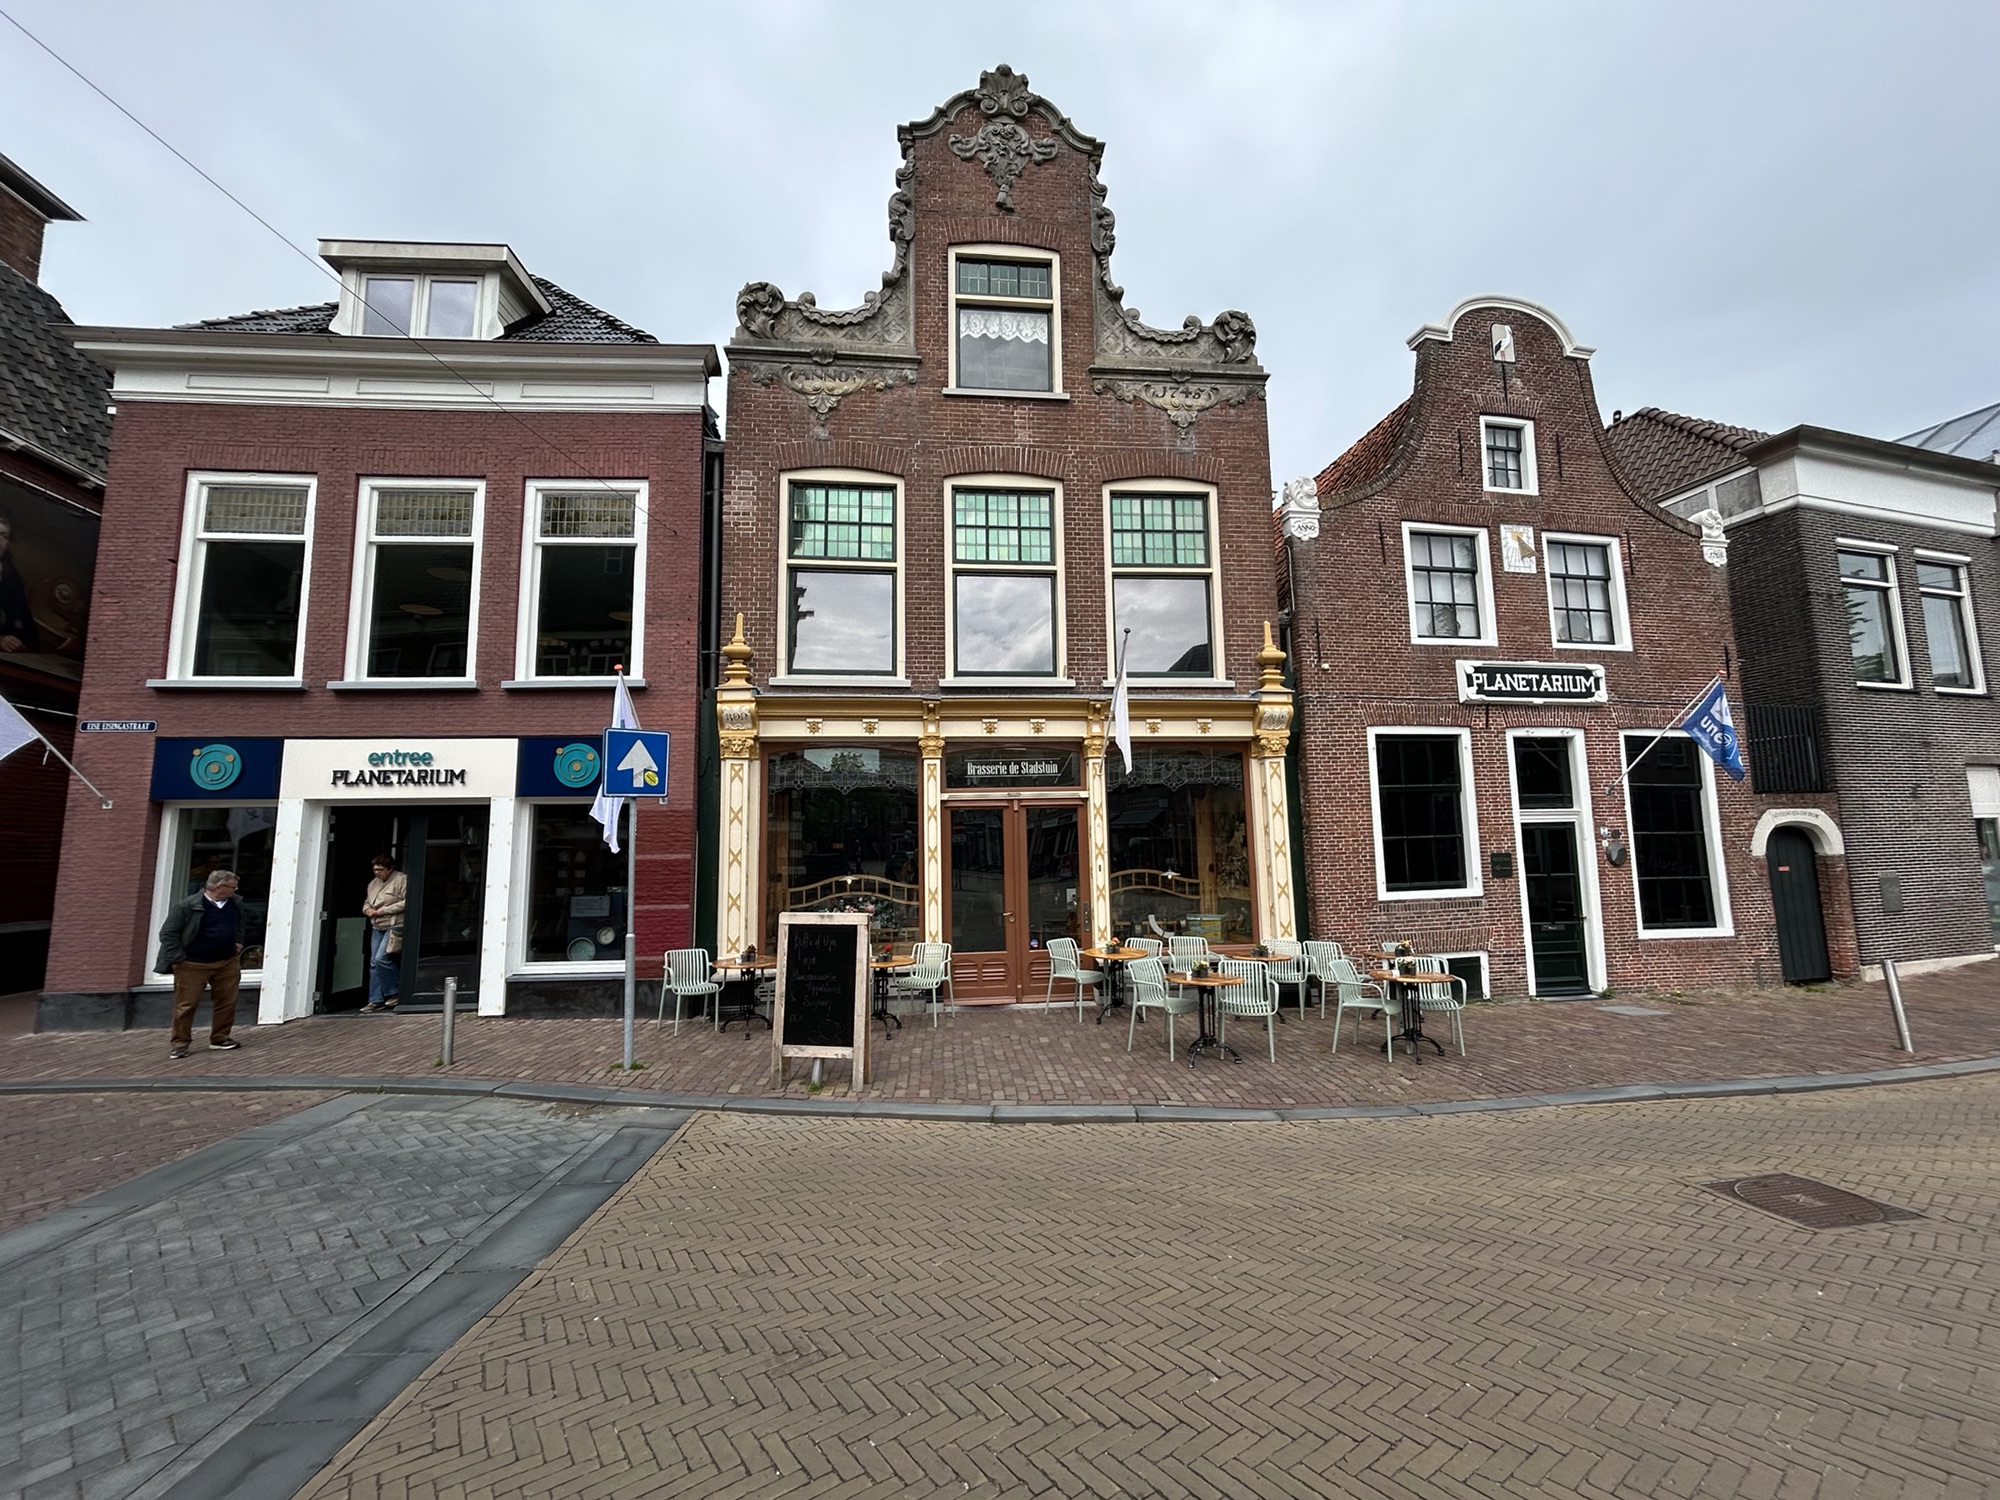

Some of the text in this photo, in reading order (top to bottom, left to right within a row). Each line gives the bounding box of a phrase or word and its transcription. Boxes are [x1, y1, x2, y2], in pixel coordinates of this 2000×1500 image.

[796, 368, 850, 382] ANNO
[1471, 673, 1597, 693] PLANETARIUM
[101, 722, 150, 730] EISINGASTRAAT
[368, 749, 434, 766] entree
[967, 761, 1059, 776] Brasserie de Stadstuin
[331, 769, 466, 785] PLANETARIUM
